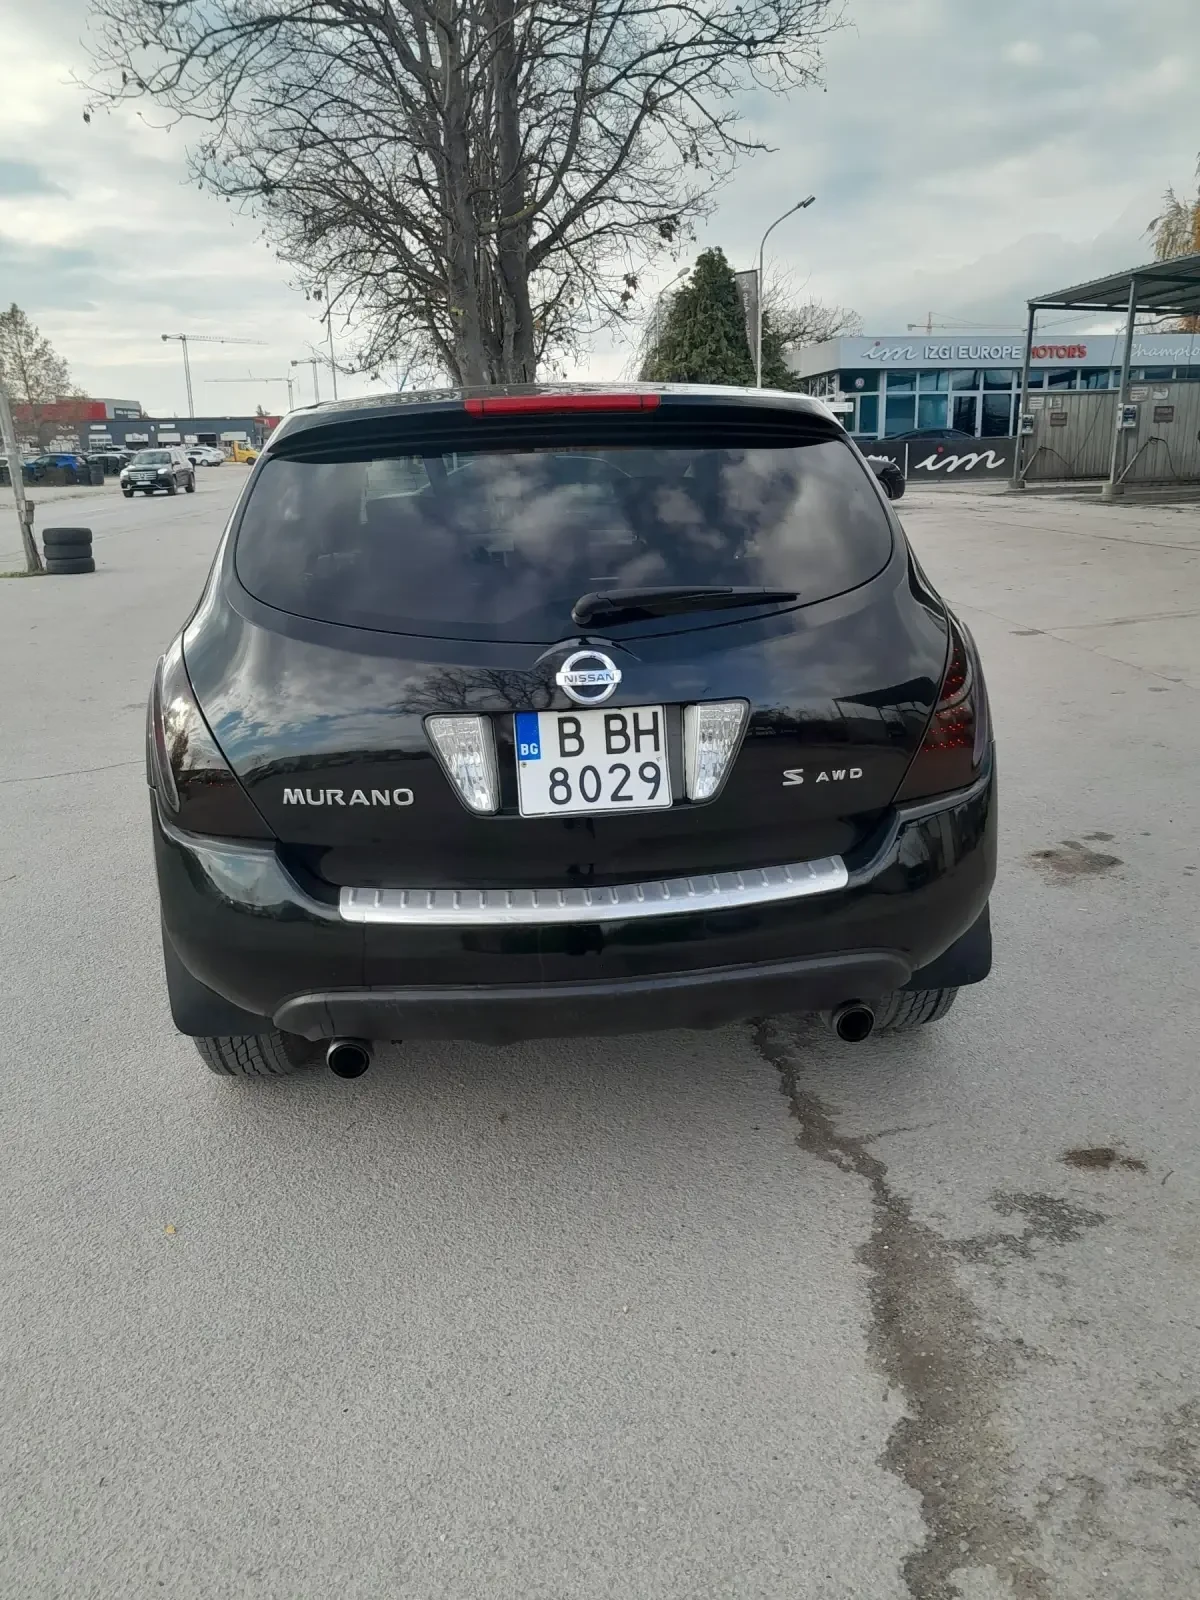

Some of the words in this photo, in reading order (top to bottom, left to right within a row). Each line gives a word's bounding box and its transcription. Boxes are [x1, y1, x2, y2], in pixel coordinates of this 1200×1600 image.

[861, 341, 919, 361] im
[924, 346, 955, 359] IZGI
[958, 345, 1022, 359] EUROPE
[564, 673, 615, 683] NISSAN
[557, 716, 585, 758] B
[604, 711, 660, 755] BH
[520, 743, 539, 756] BG
[548, 761, 661, 806] 8029
[782, 768, 804, 786] S
[815, 767, 863, 783] AWD
[282, 788, 414, 806] MURANO
